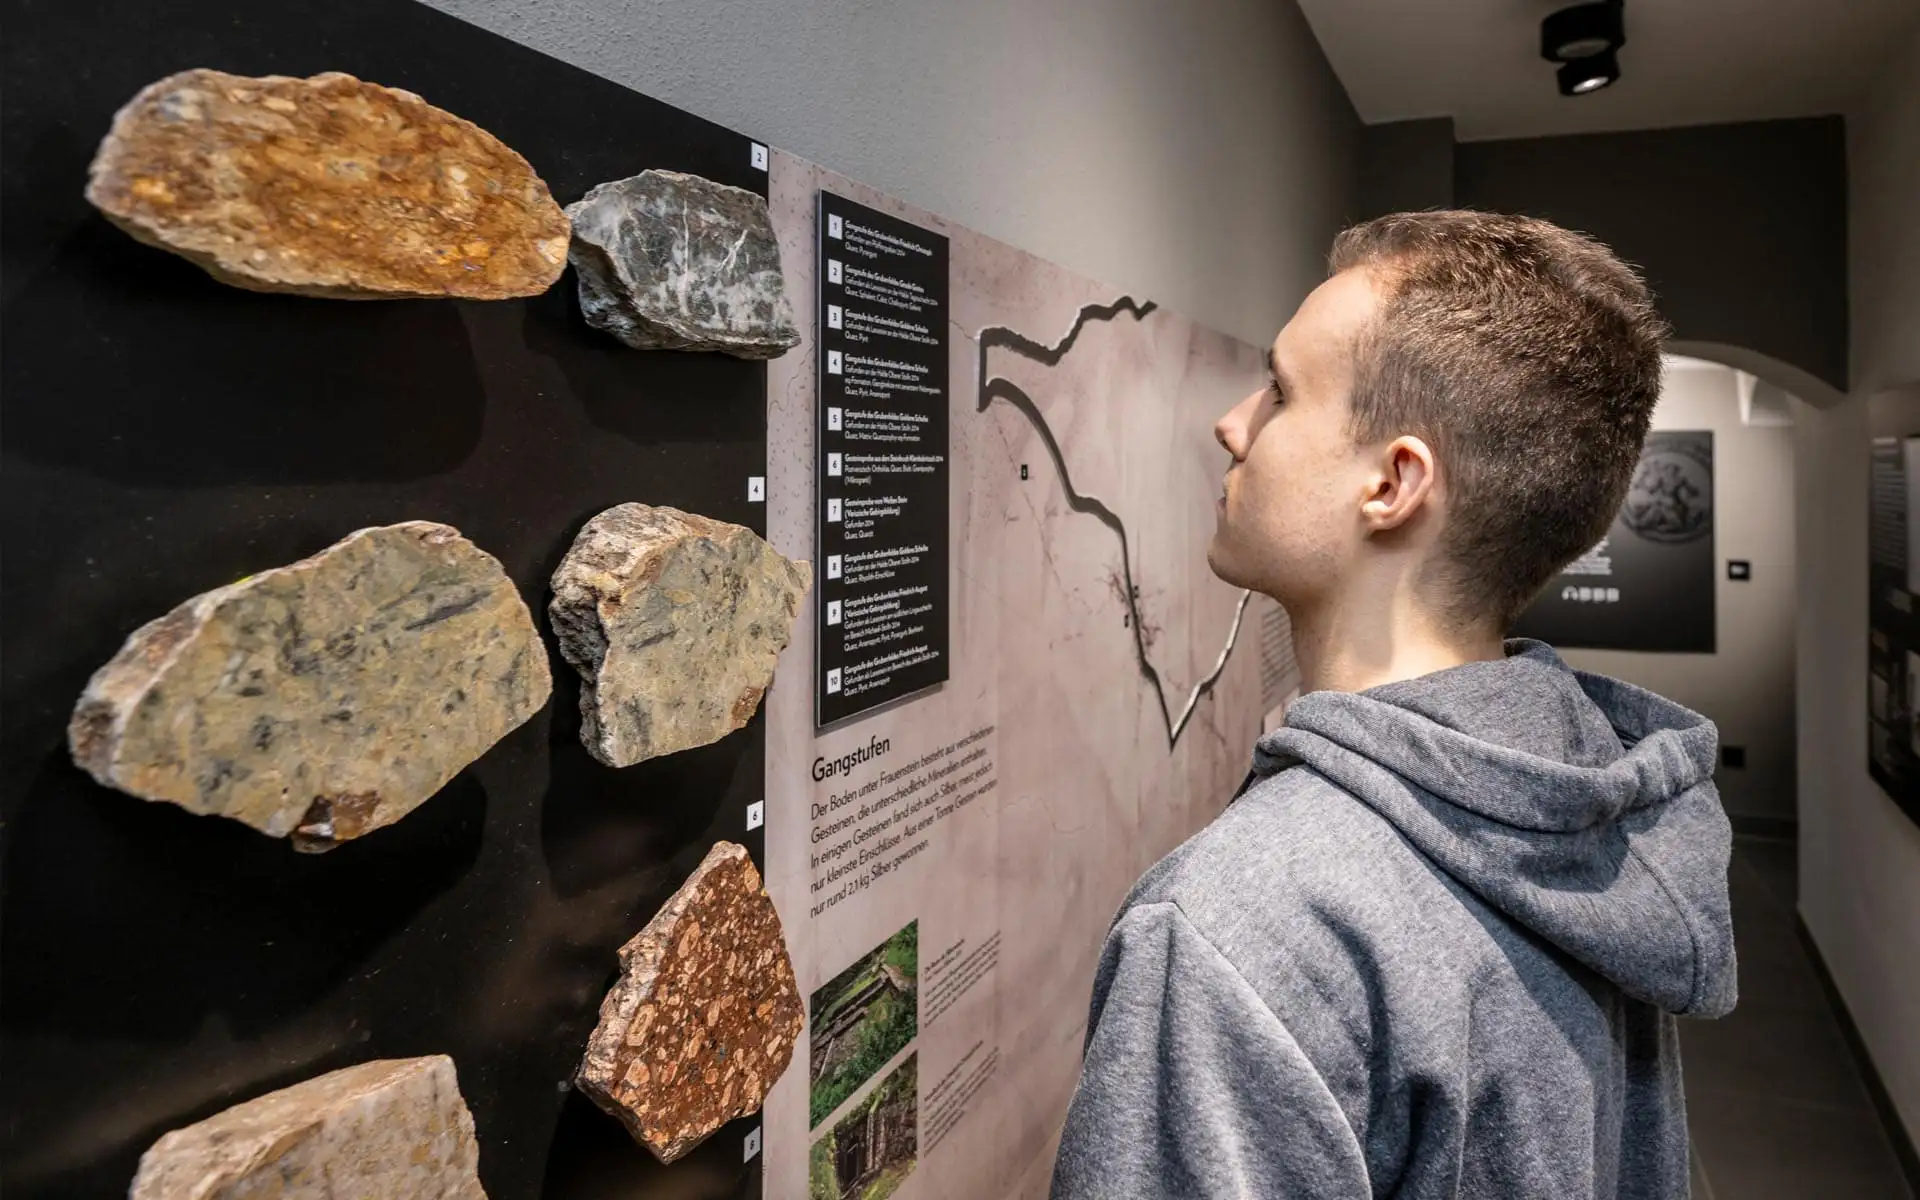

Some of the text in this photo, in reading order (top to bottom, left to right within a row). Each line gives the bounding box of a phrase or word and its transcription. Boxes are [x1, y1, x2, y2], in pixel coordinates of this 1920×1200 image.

[757, 152, 762, 162] 2
[833, 267, 838, 276] 2
[833, 312, 838, 321] 3
[833, 358, 838, 366] 4
[833, 414, 837, 423] 5
[833, 460, 837, 468] 6
[753, 485, 758, 494] 4
[833, 505, 837, 514] 7
[830, 676, 838, 686] 10
[812, 735, 890, 782] Gangstufen
[812, 803, 828, 820] Der
[830, 789, 857, 811] Boden
[858, 780, 878, 797] unter
[880, 759, 920, 787] Frauenstein
[752, 810, 757, 821] 6
[811, 815, 856, 843] Gesteinen,
[858, 804, 870, 820] die
[811, 853, 819, 870] In
[820, 840, 852, 863] einigen
[853, 818, 892, 844] Gesteinen
[893, 803, 909, 824] fand
[910, 798, 923, 814] sich
[924, 788, 939, 806] auch
[811, 878, 825, 894] nur
[827, 859, 858, 884] kleinste
[904, 825, 917, 840] Aus
[918, 814, 934, 831] einer
[936, 804, 954, 820] Tonne
[810, 902, 825, 918] nur
[827, 882, 846, 908] rund
[848, 878, 858, 896] 2,1
[860, 873, 870, 889] kg
[871, 861, 891, 880] Silber
